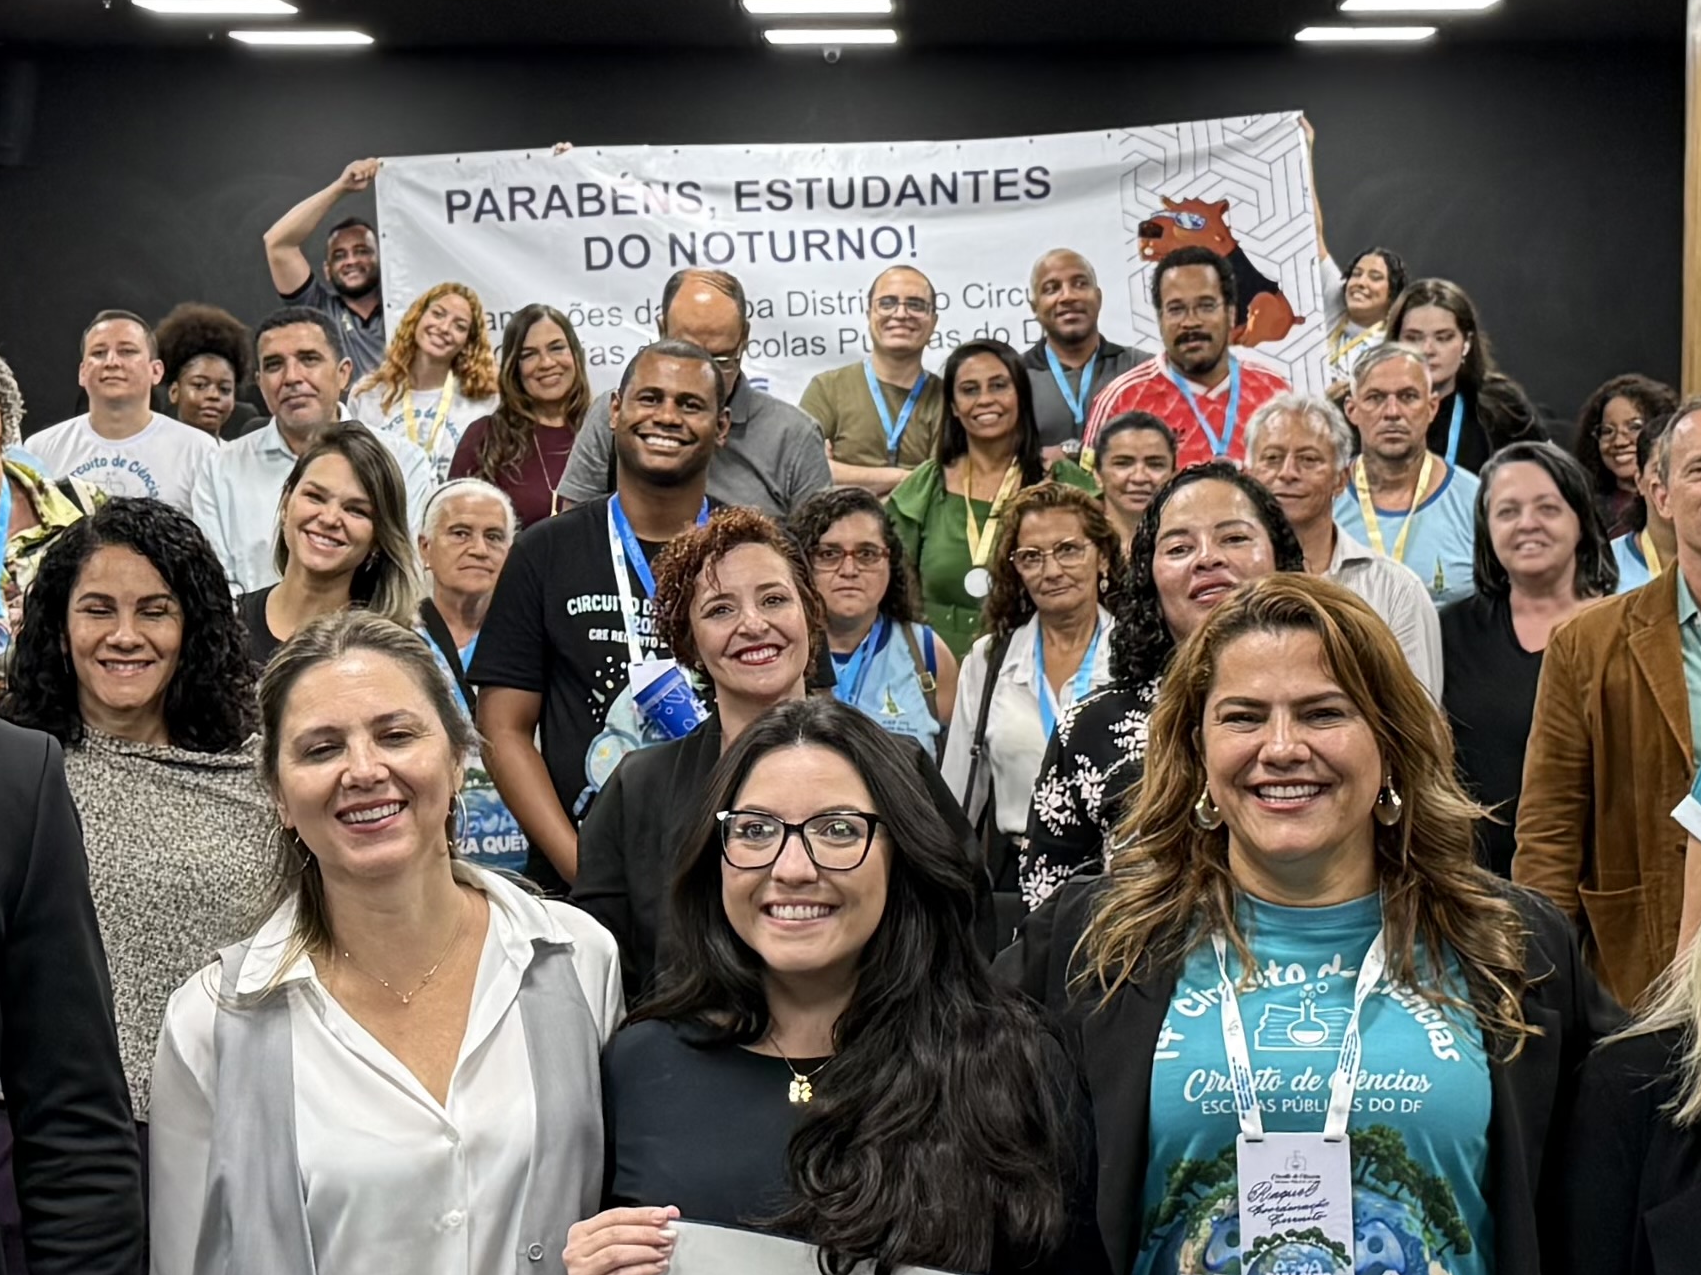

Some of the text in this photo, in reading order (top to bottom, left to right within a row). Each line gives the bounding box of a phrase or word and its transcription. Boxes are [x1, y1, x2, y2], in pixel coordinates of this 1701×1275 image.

[445, 166, 1051, 224] PARABÉNS, ESTUDANTES
[584, 224, 918, 271] DO NOTURNO!
[787, 289, 867, 317] Distri
[746, 331, 826, 359] colas
[70, 456, 108, 477] rcuito
[111, 455, 128, 468] de
[567, 594, 641, 616] CIRCUIO
[1291, 1066, 1323, 1091] de
[1369, 1097, 1395, 1112] DO
[1401, 1099, 1423, 1113] DF
